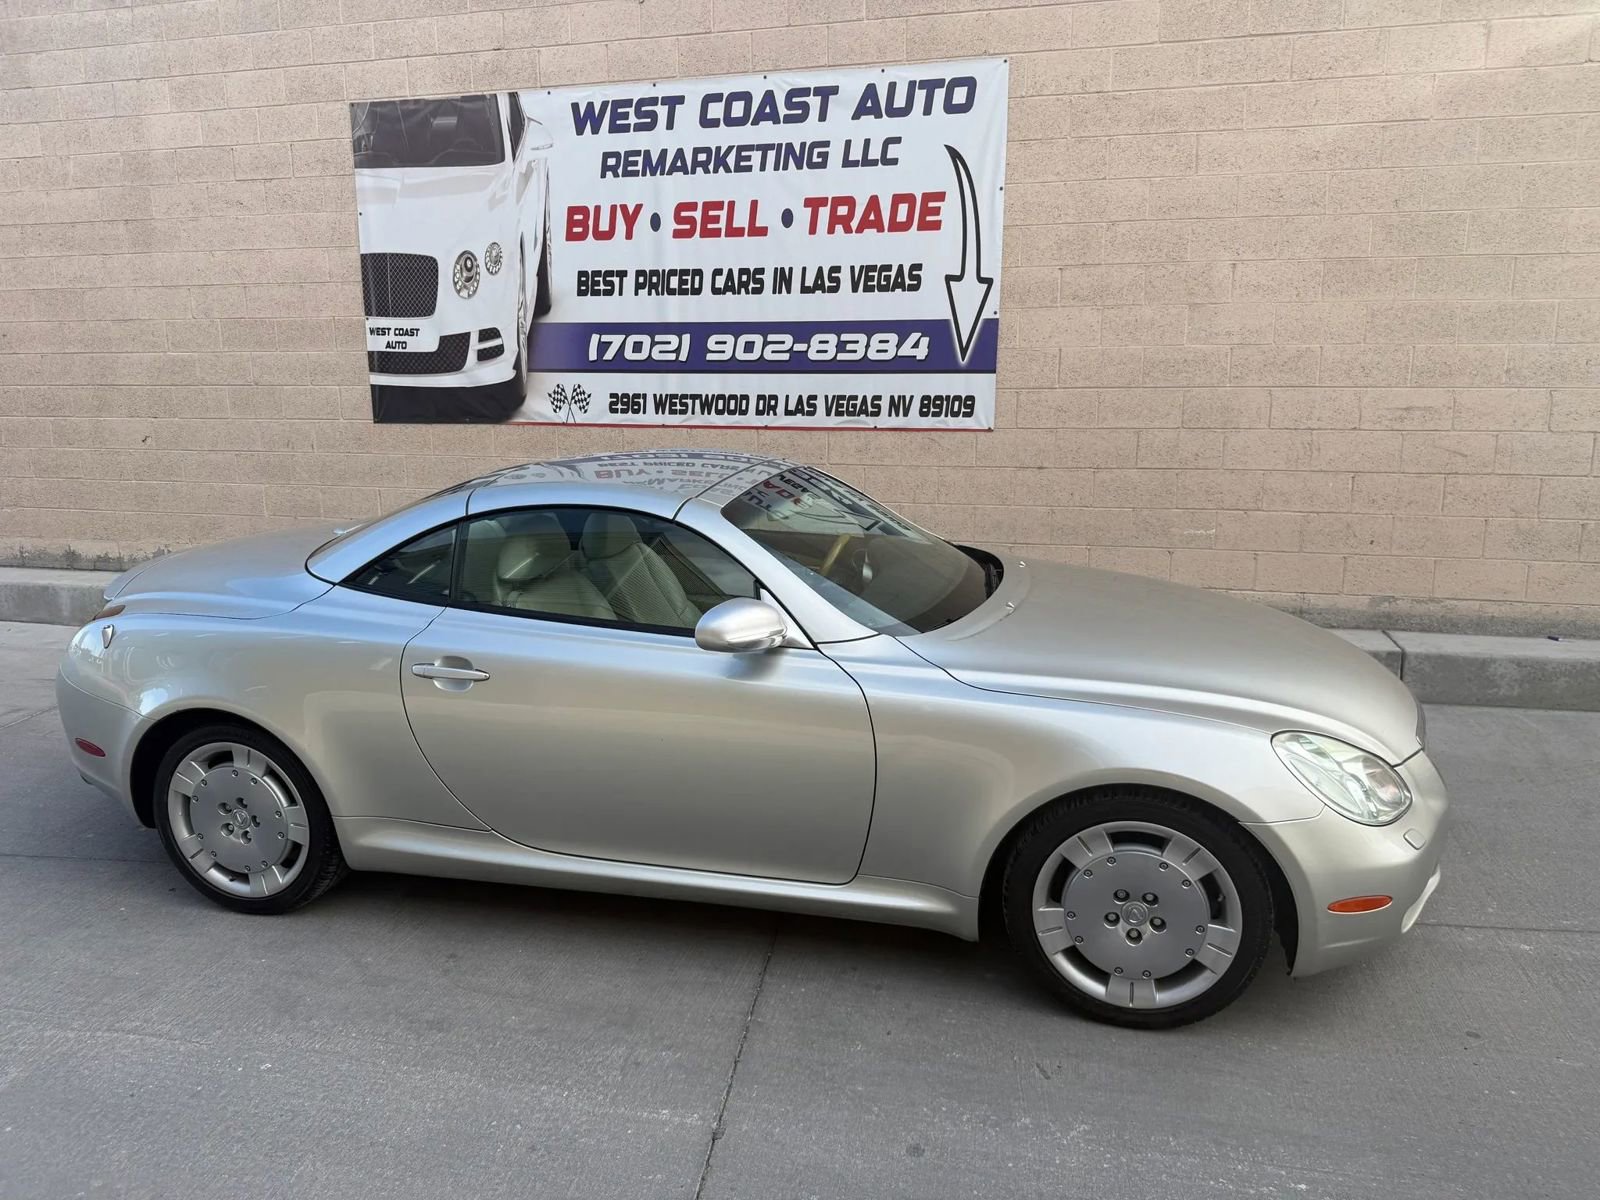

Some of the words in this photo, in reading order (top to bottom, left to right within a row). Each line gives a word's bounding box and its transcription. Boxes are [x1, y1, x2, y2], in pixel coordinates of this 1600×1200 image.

[571, 95, 686, 136] WEST
[699, 85, 839, 128] COAST
[851, 76, 977, 121] AUTO
[600, 140, 830, 179] REMARKETING
[841, 136, 902, 168] LLC
[565, 203, 644, 242] BUY
[672, 199, 769, 239] SELL
[803, 191, 947, 236] TRADE
[577, 269, 628, 297] BEST
[634, 268, 704, 296] PRICED
[711, 267, 766, 295] CARS
[772, 266, 793, 295] IN
[800, 265, 841, 294] LAS
[850, 263, 923, 293] VEGAS
[369, 327, 391, 336] WEST
[394, 327, 420, 337] COAST
[385, 340, 407, 350] AUTO
[588, 333, 691, 362] (702)
[705, 332, 930, 362] 902-8384
[608, 392, 647, 415] 2961
[653, 393, 749, 416] WESTWOOD
[755, 394, 779, 416] DR
[784, 394, 817, 417] LAS
[824, 394, 882, 417] VEGAS
[888, 395, 914, 418] NV
[918, 395, 976, 418] 89109
